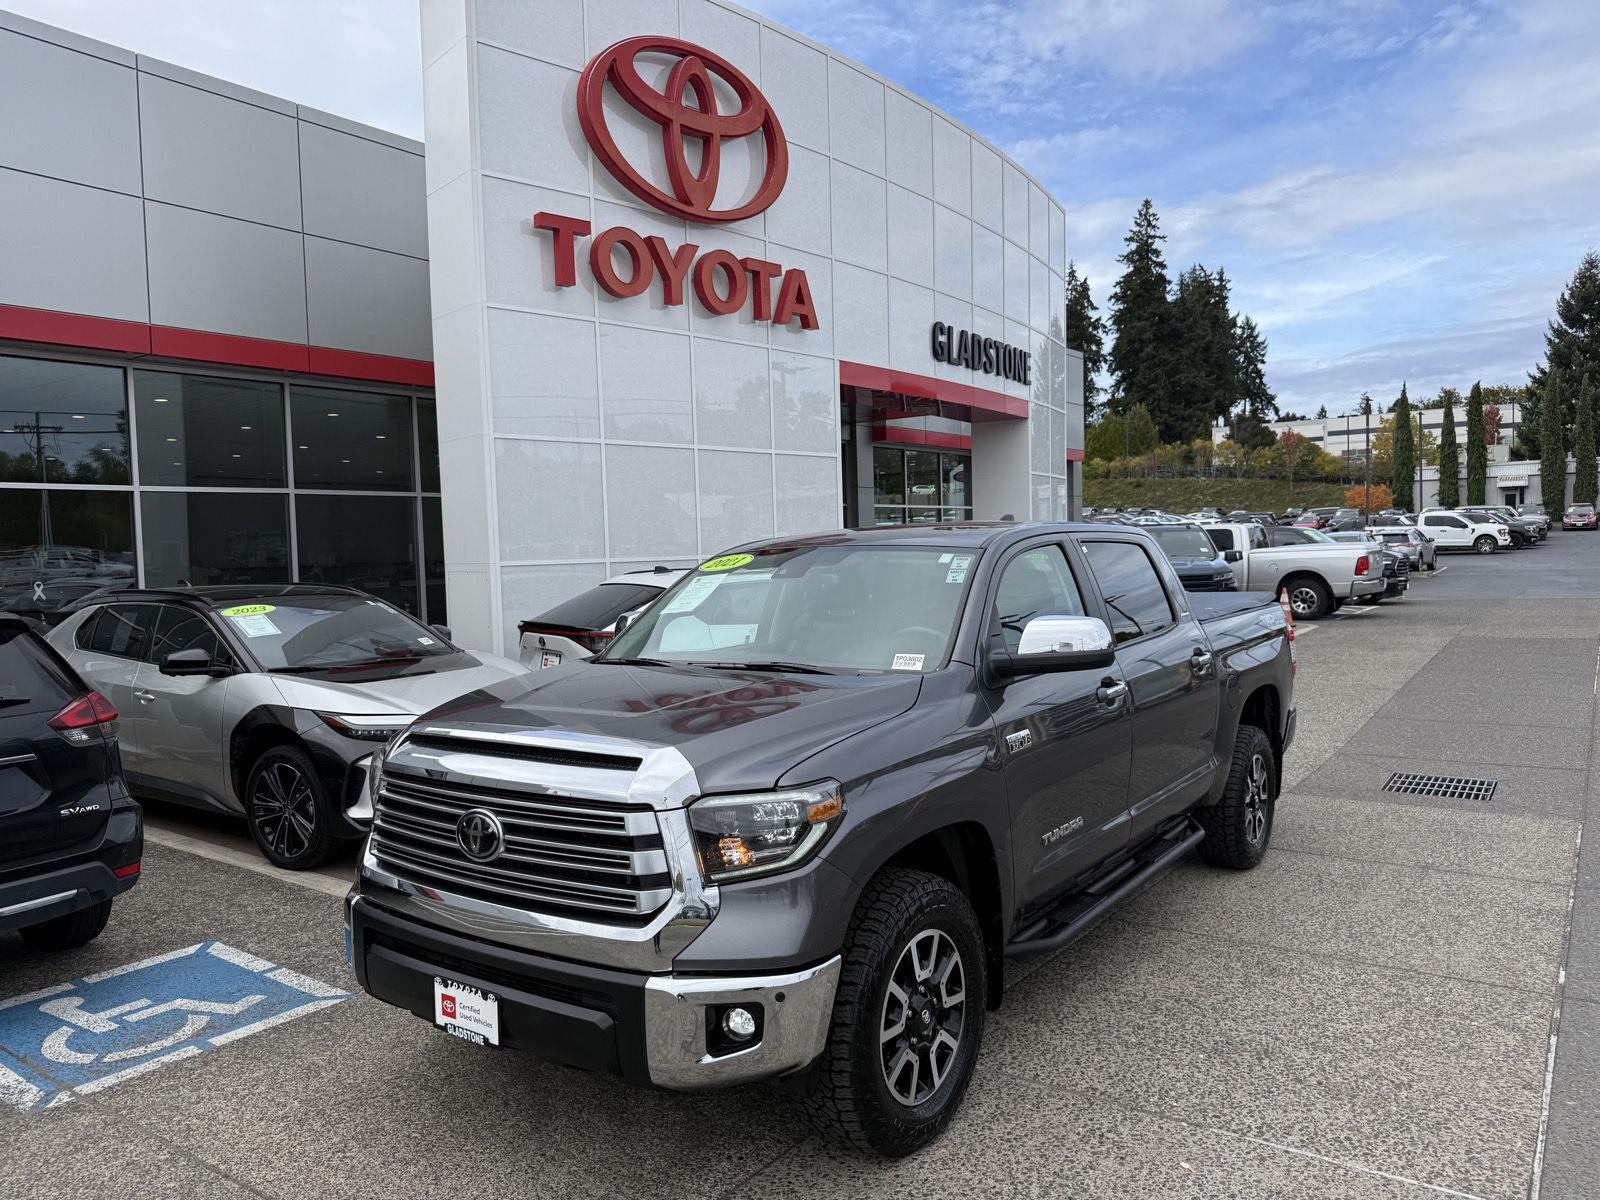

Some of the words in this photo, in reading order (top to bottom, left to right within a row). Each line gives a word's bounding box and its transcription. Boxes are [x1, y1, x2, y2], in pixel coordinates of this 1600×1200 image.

[533, 211, 820, 331] TOYOTA
[932, 321, 1032, 386] GLADSTONE
[232, 606, 267, 615] 2023
[60, 806, 80, 817] SV
[79, 804, 100, 814] AWD
[1040, 815, 1085, 848] TUNDRA
[447, 980, 482, 997] TOYOTA
[459, 1003, 481, 1014] Certified
[459, 1011, 473, 1022] Used
[473, 1016, 494, 1029] Vehicles
[447, 1024, 485, 1045] GLADSTONE
